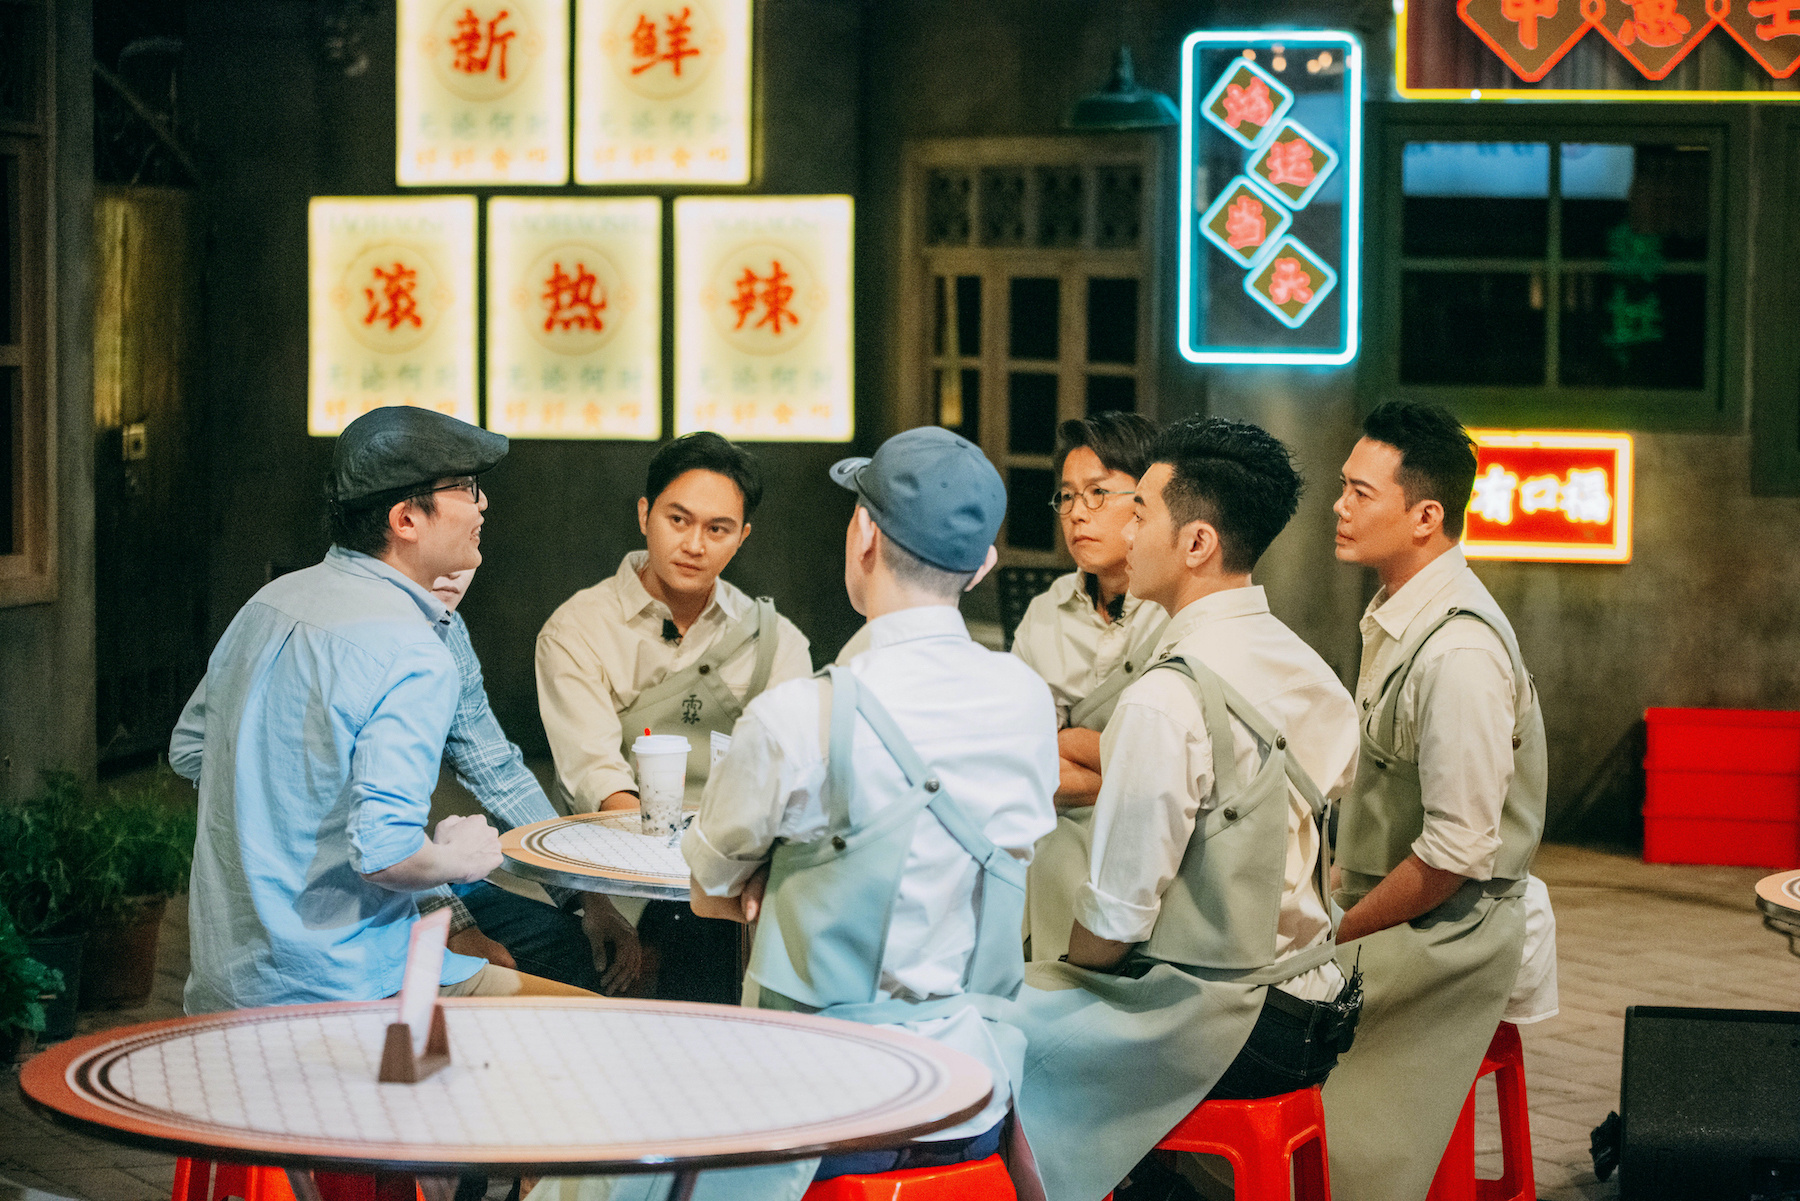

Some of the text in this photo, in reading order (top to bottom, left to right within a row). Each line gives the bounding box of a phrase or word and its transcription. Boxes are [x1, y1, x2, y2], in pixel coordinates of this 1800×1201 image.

[448, 7, 519, 82] 新
[629, 6, 701, 78] 鲜
[363, 261, 424, 332] 滚
[541, 262, 608, 334] 热
[728, 260, 800, 335] 辣
